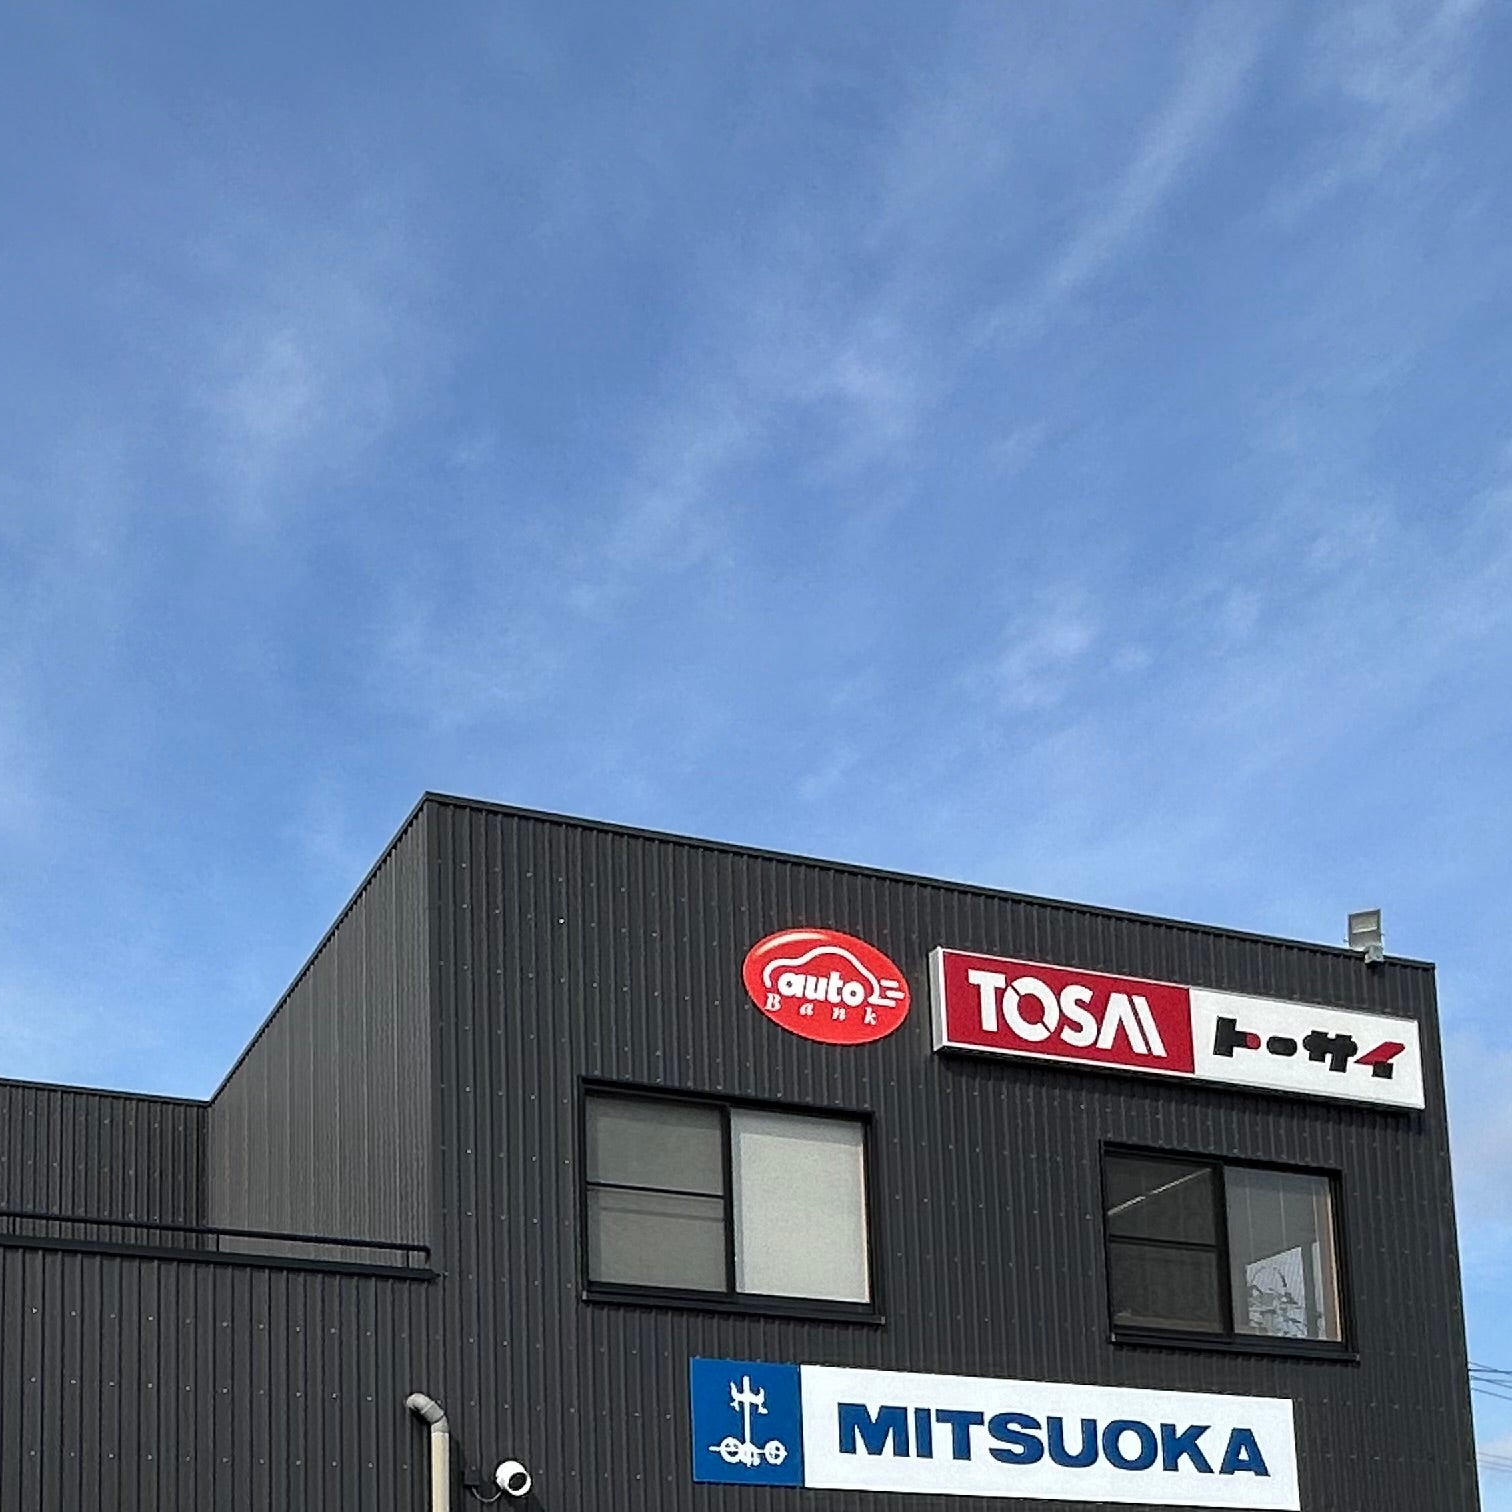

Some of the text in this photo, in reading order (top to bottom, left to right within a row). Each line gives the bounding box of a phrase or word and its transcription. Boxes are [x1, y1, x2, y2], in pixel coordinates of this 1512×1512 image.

[765, 993, 877, 1025] Bank
[778, 971, 865, 1006] auto
[1213, 1015, 1406, 1079] トーサイ
[838, 1402, 1271, 1477] MITSUOKA
